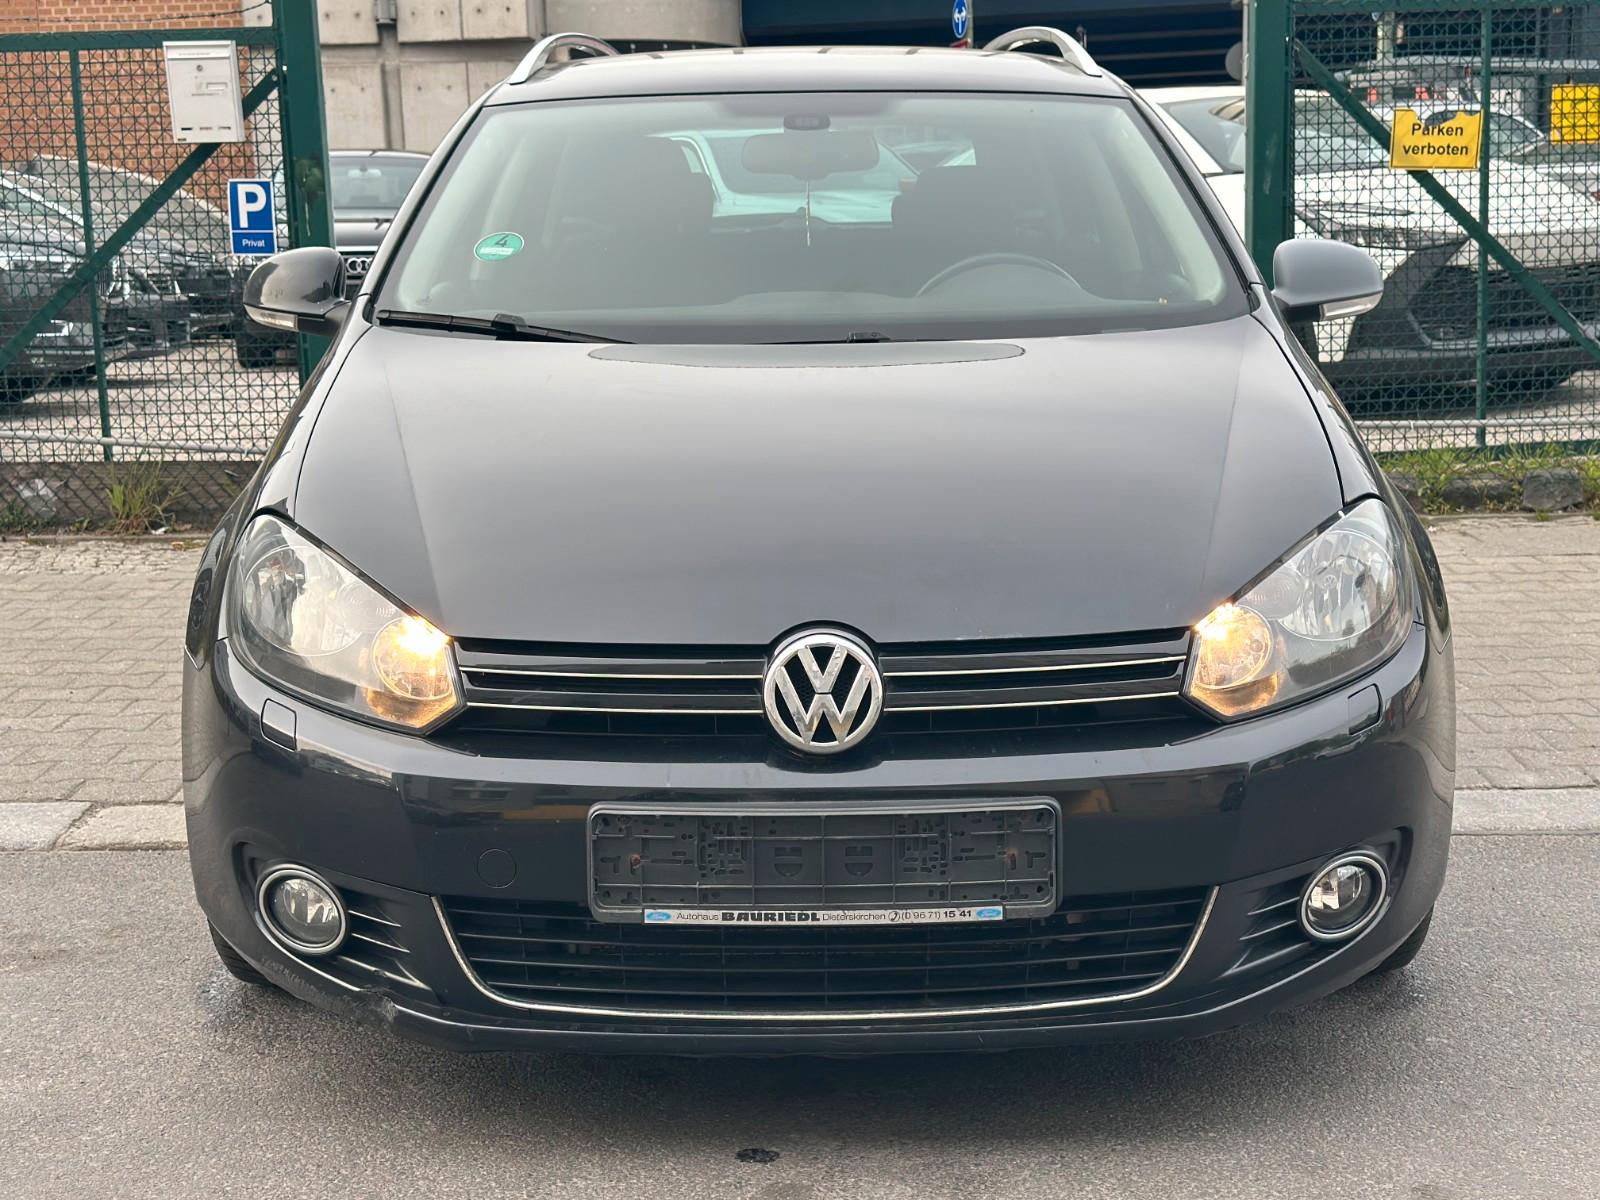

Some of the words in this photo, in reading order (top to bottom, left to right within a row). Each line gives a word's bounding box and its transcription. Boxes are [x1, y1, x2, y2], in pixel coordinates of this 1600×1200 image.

[1411, 123, 1464, 136] Parken
[1403, 142, 1469, 155] verboten
[237, 183, 267, 228] P
[242, 238, 265, 247] Privat
[494, 234, 509, 247] 4
[676, 912, 719, 921] Autohaus
[722, 911, 820, 922] BAURIEDL
[959, 910, 972, 918] 41
